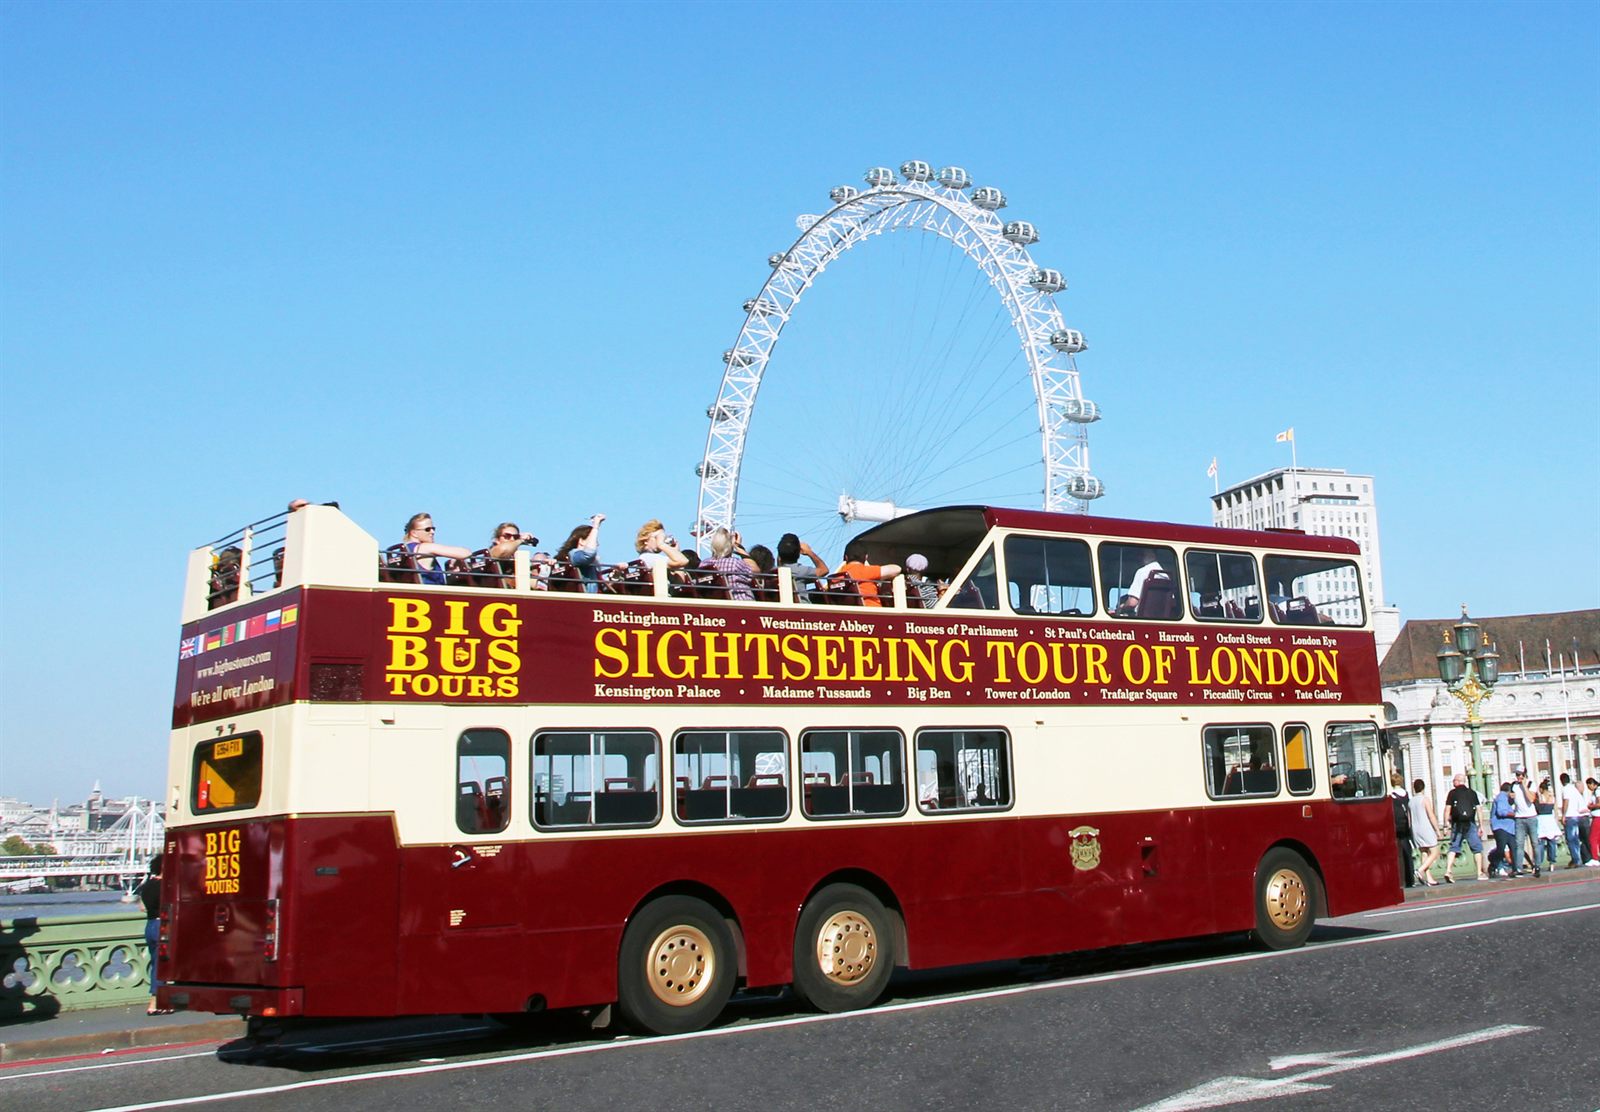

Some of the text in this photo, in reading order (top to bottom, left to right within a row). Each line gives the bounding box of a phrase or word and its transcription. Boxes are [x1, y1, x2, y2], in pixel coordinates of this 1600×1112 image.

[386, 597, 523, 637] BIG
[592, 610, 1337, 648] Buckingham Palace Westminster Abbey Houses of Parliament St Paul's Cathedral Harrods Oxford Street London Eye
[197, 651, 272, 679] www.bigbustours.com
[386, 635, 522, 675] BUS
[594, 627, 1339, 686] SIGHTSEEING TOUR OF LONDON
[191, 675, 275, 708] We're all over London
[385, 673, 519, 698] TOURS
[593, 684, 1343, 702] Kensington Palace Madame Tussauds Big Ben Tower of London Trafalgar Square Piccadilly Circus Tate Gallery
[205, 829, 241, 855] BIG
[205, 854, 241, 879] BUS
[205, 879, 240, 894] TOURS
